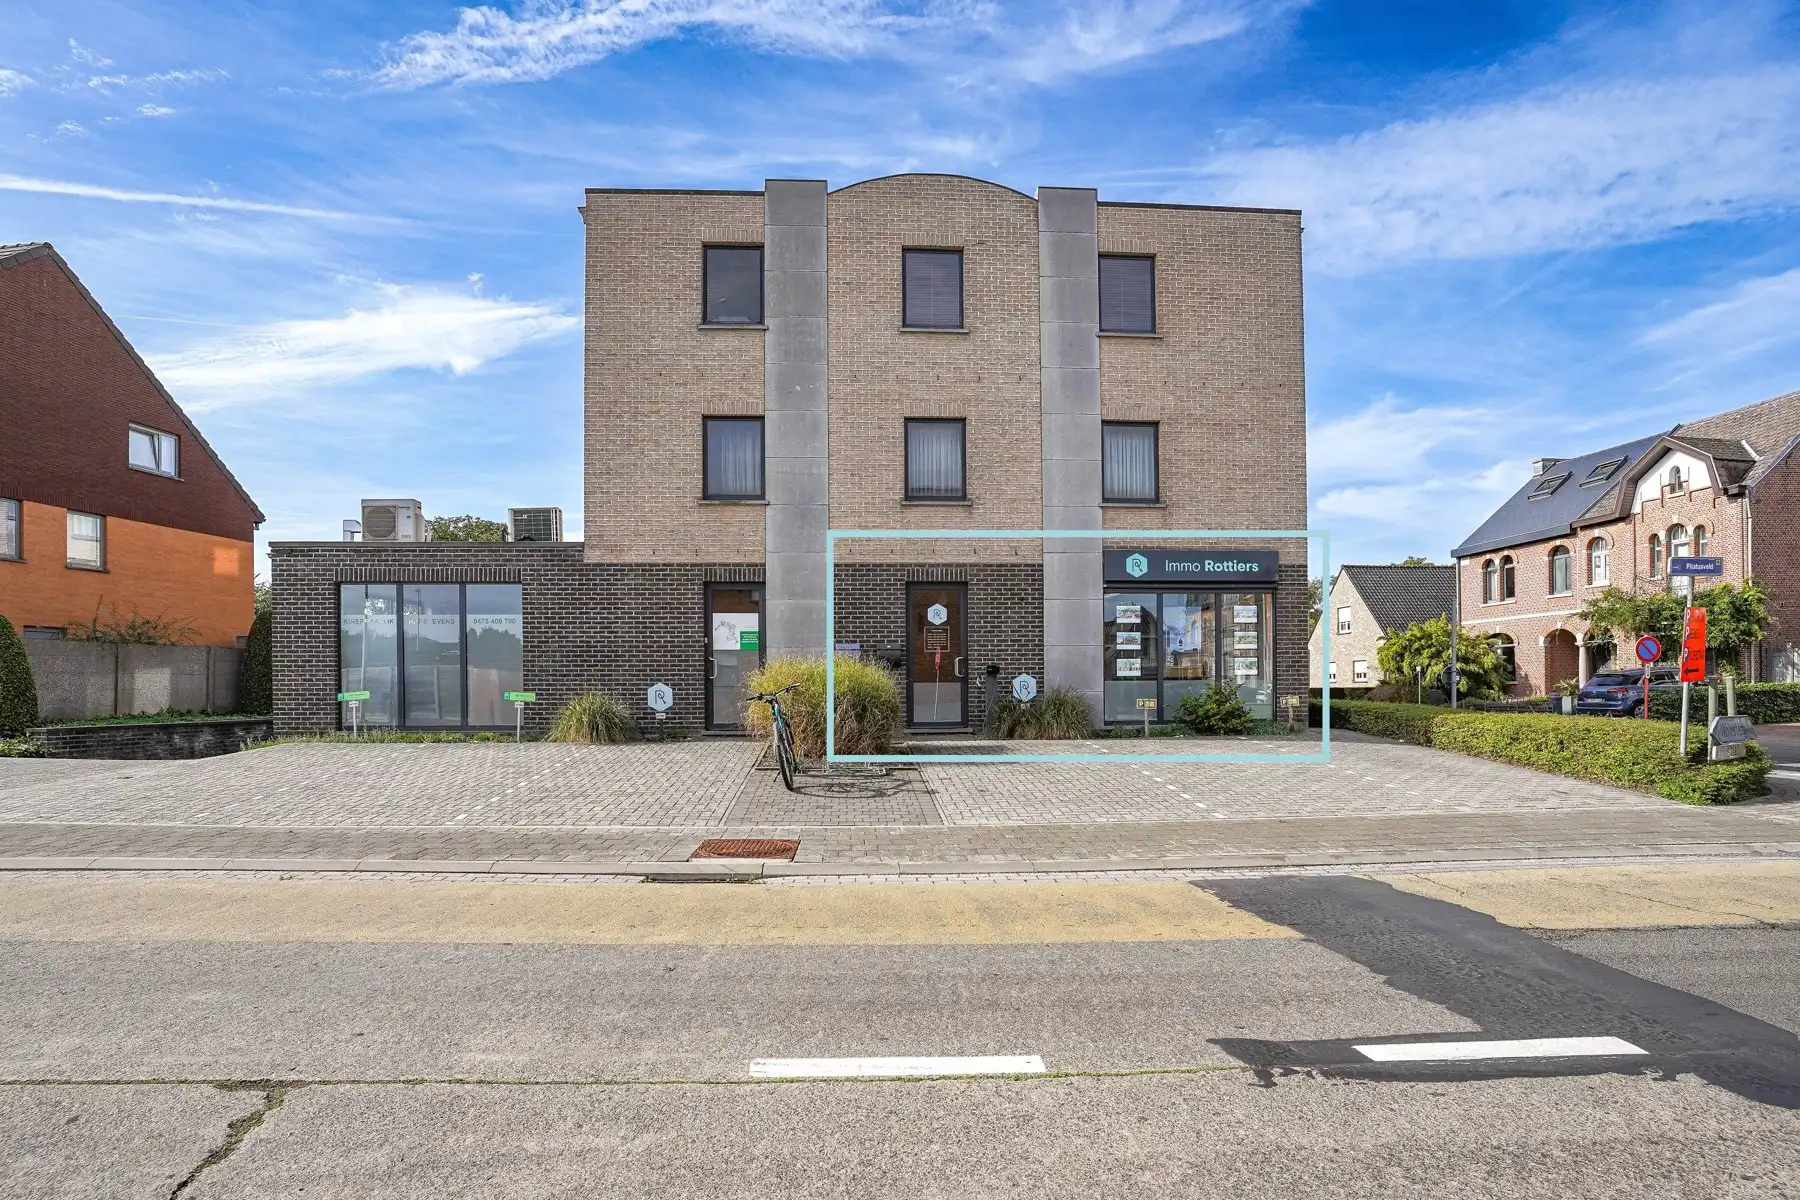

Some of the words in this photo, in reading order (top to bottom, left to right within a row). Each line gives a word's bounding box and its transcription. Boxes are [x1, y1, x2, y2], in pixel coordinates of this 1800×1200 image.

[1165, 559, 1201, 572] Immo
[1204, 559, 1259, 572] Rottiers
[1686, 562, 1714, 571] Pilatusveld
